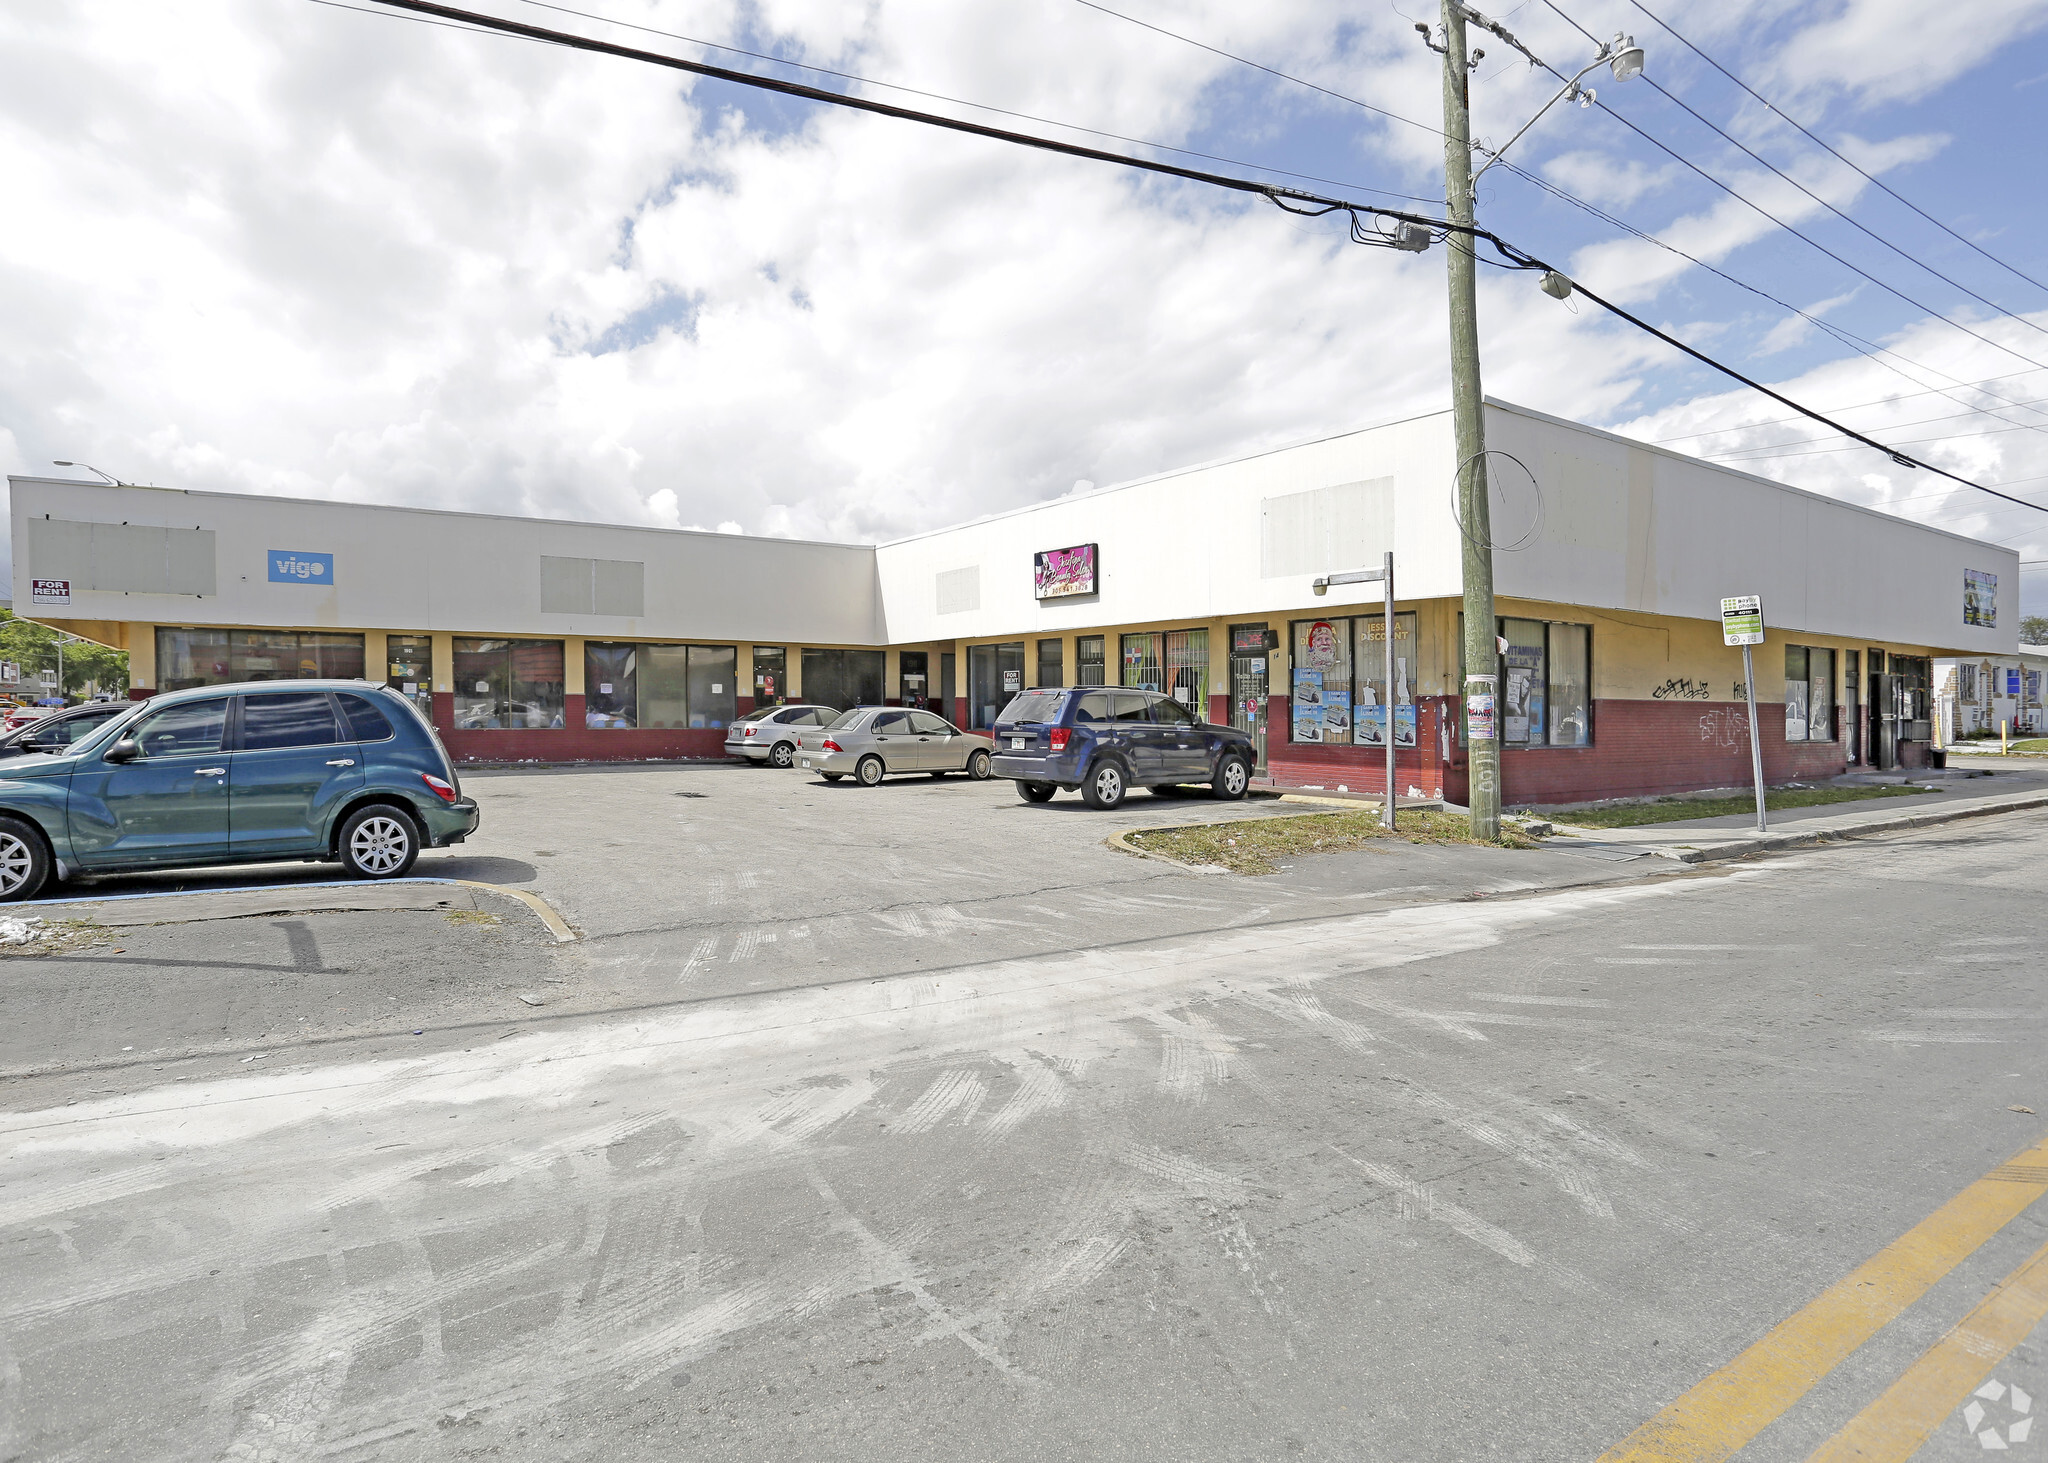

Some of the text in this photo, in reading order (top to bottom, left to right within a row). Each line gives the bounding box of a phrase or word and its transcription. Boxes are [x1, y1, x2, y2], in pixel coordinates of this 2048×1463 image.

[276, 556, 325, 579] vigo
[1367, 622, 1401, 633] JESSA
[1361, 631, 1408, 640] DISCONT
[1507, 645, 1543, 657] VITAMINAS
